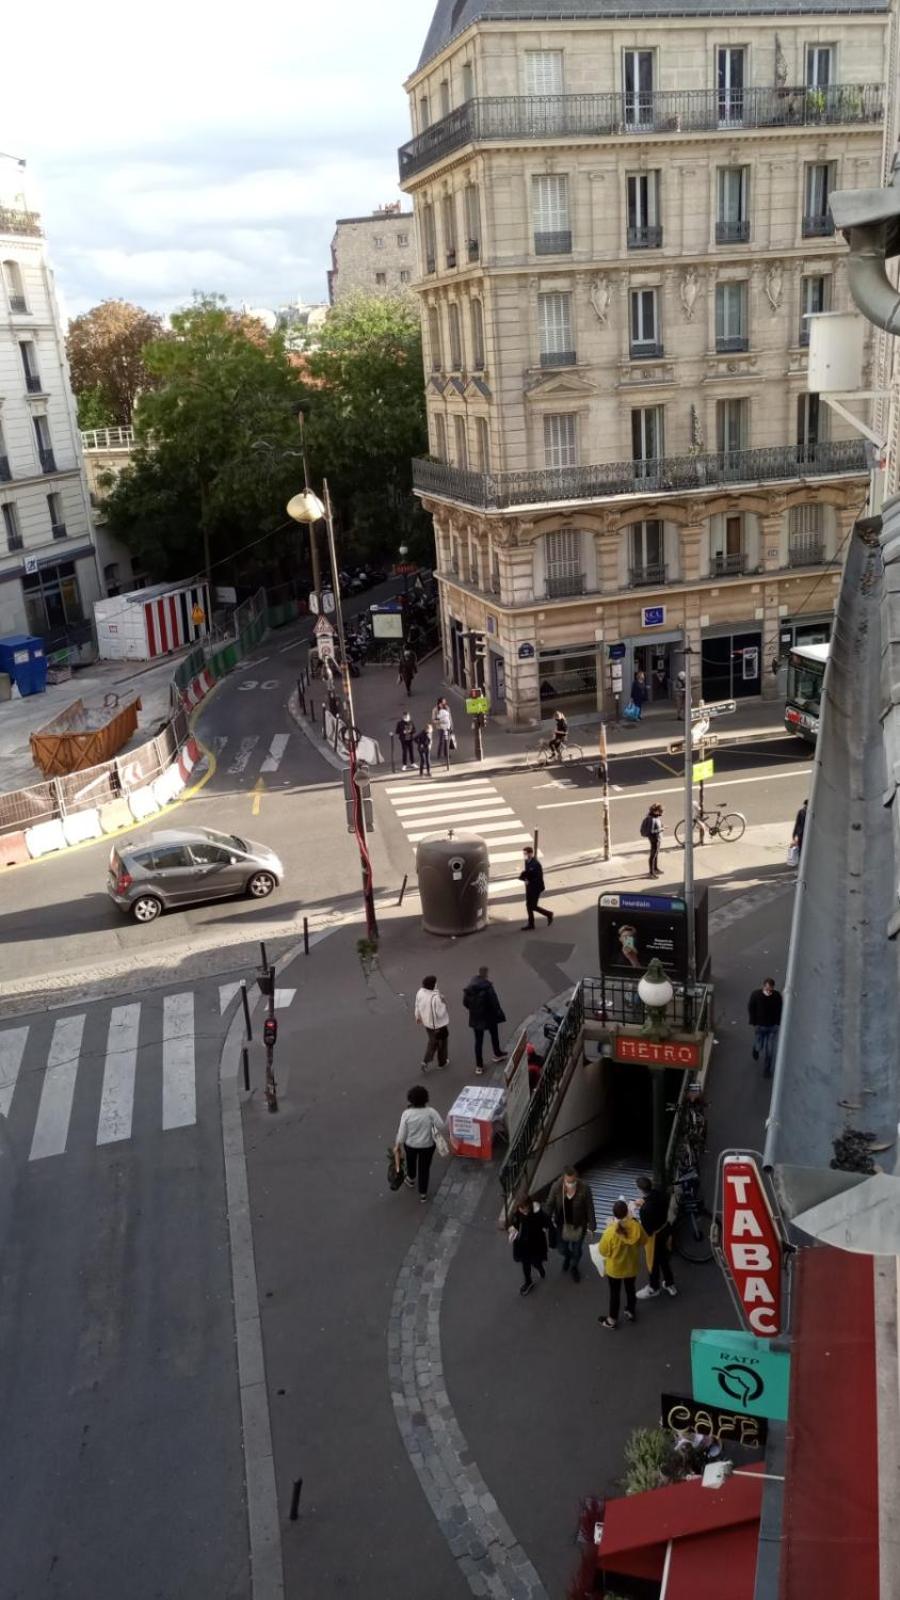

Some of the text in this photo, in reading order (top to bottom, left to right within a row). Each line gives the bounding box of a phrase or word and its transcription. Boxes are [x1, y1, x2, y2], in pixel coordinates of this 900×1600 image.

[621, 1040, 692, 1063] METRO
[726, 1175, 778, 1333] TABAC
[720, 1352, 760, 1365] RATP
